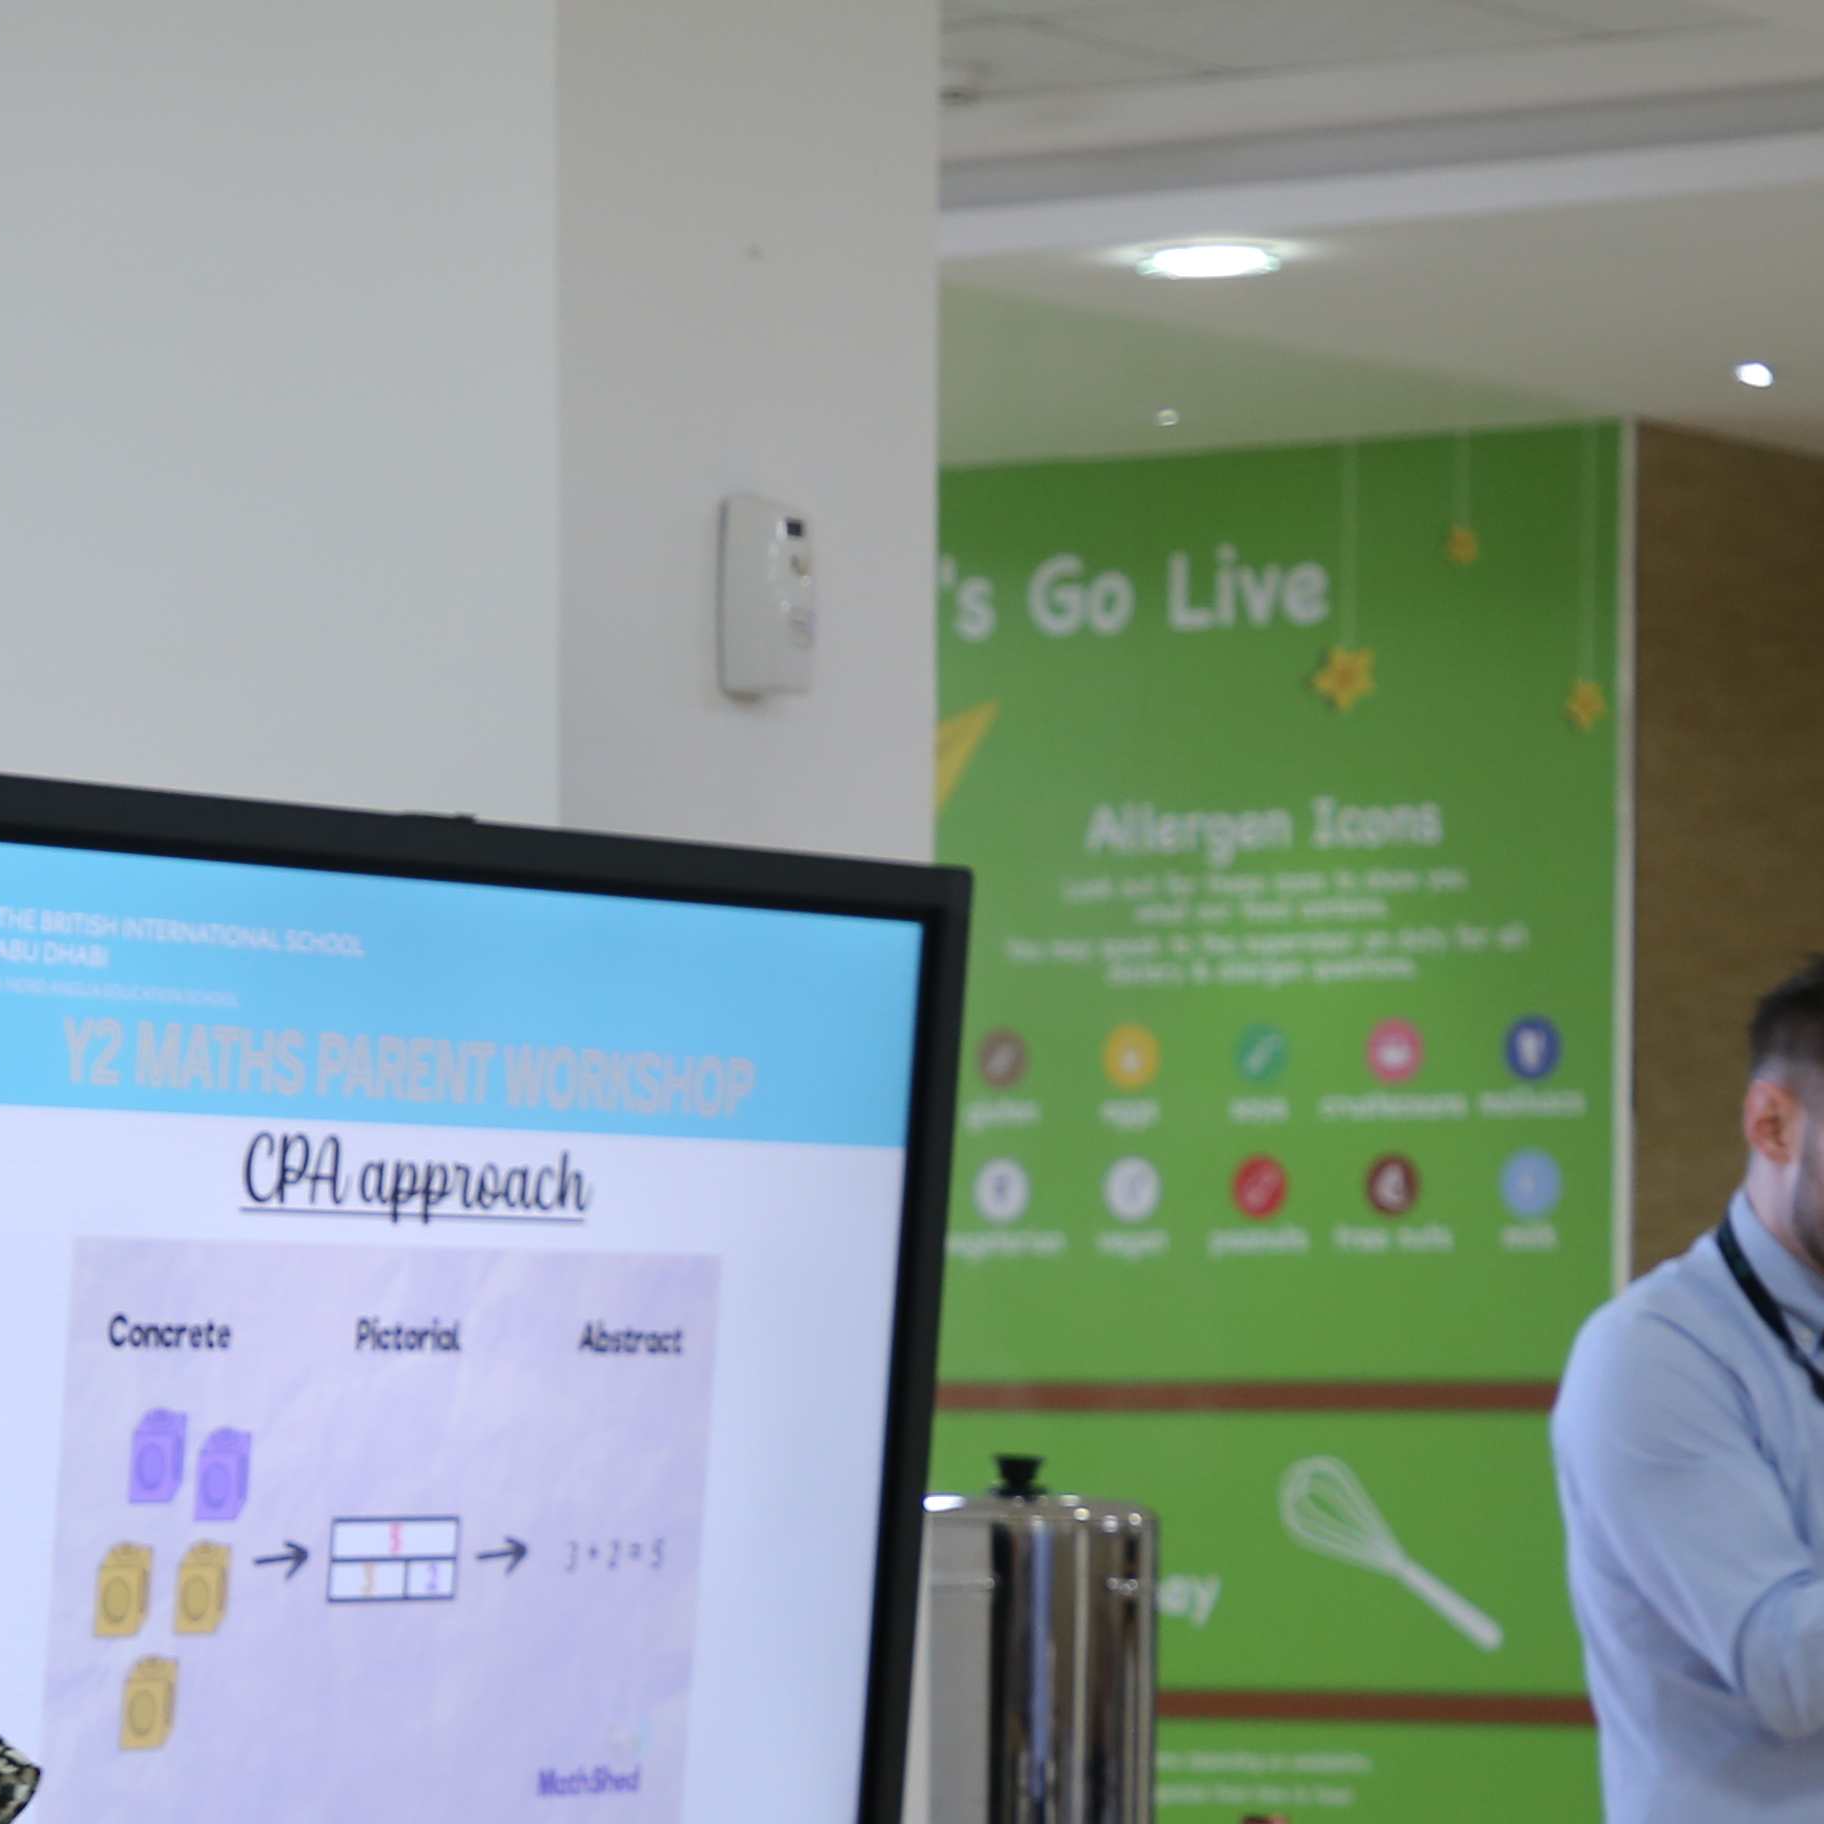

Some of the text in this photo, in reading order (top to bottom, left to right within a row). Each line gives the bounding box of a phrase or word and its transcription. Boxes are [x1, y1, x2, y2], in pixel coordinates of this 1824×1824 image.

[1028, 553, 1134, 636] Go
[1166, 542, 1330, 631] Live
[1084, 797, 1443, 868] Allergen Icons
[41, 911, 118, 938] BRITISH
[121, 917, 280, 952] INTERNATIONAL
[286, 929, 366, 960] SCHOOL
[42, 942, 110, 968] DHABI
[64, 1016, 756, 1121] Y2 MATHS PARENT WORKSHOP
[243, 1132, 594, 1225] CPA approach
[108, 1314, 232, 1350] Concrete
[355, 1317, 463, 1353] Pictorial
[578, 1321, 684, 1356] Abstract
